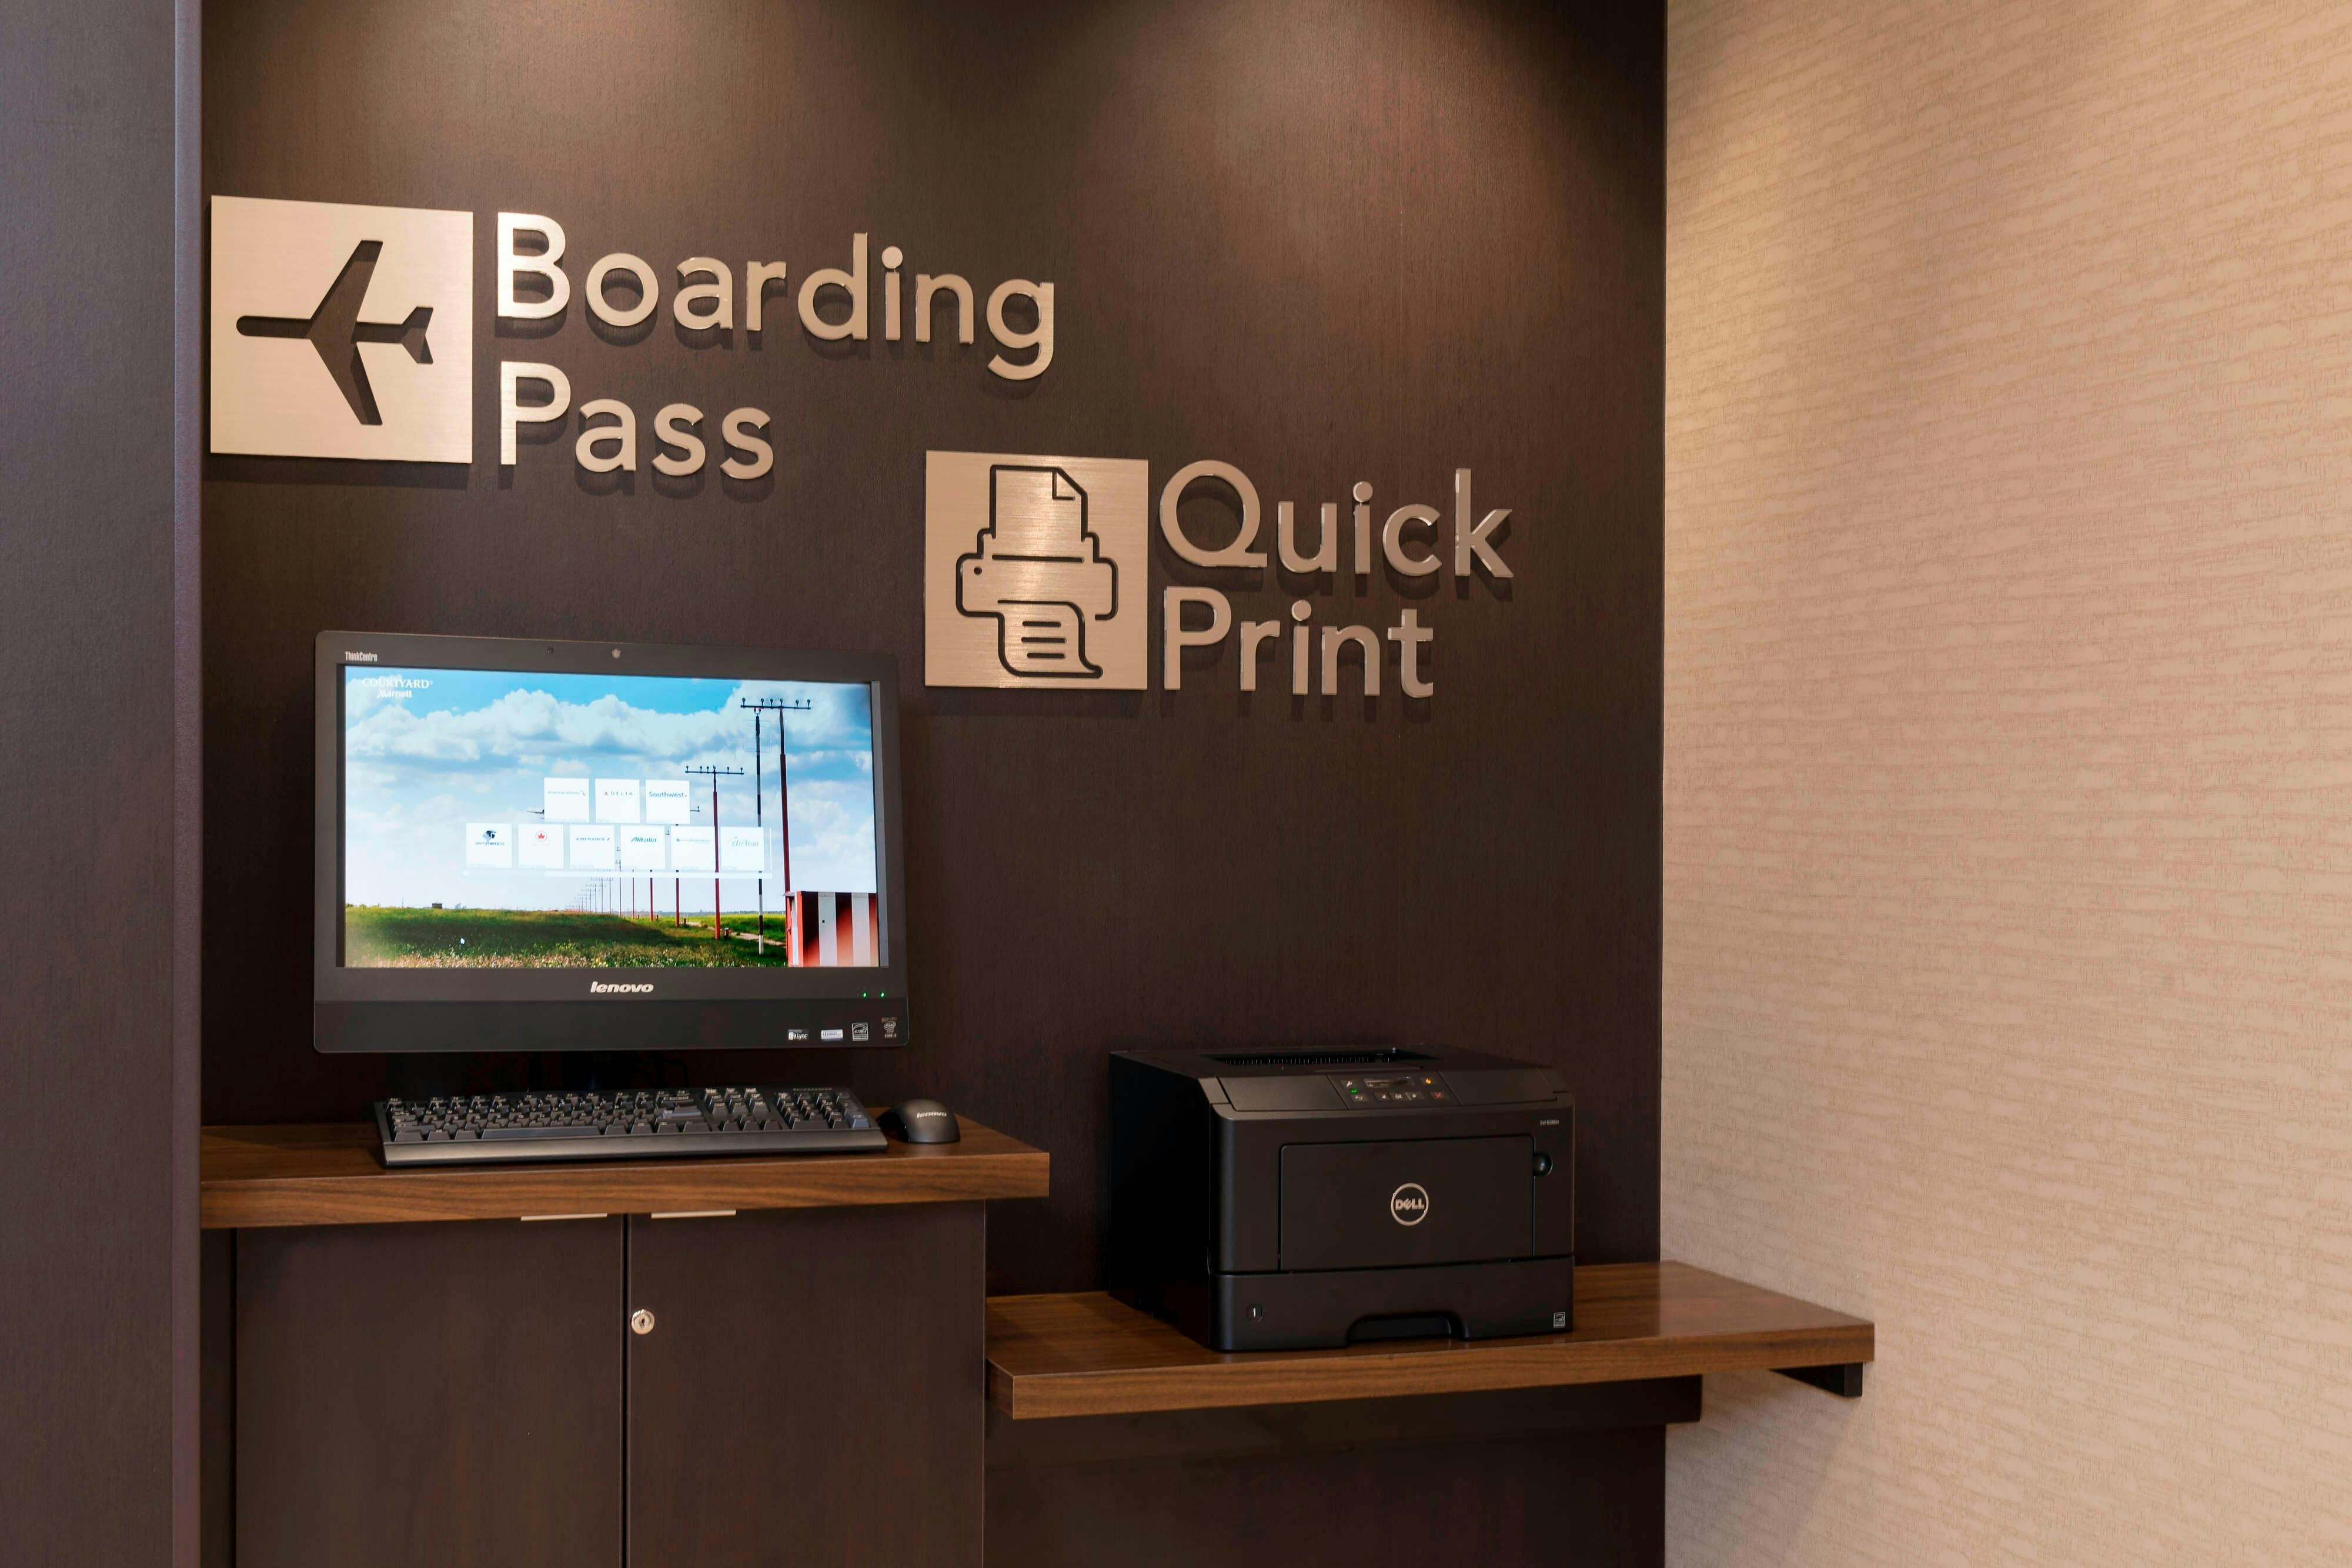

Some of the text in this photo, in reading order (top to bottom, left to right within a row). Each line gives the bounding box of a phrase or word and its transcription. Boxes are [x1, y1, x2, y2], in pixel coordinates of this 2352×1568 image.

[496, 212, 1055, 380] Boarding
[499, 361, 774, 479] Pass
[1158, 459, 1514, 578] Quick
[345, 651, 378, 663] ThinkCentre
[1164, 586, 1434, 698] Print
[590, 981, 654, 993] lenovo
[1395, 1198, 1425, 1211] DELL
